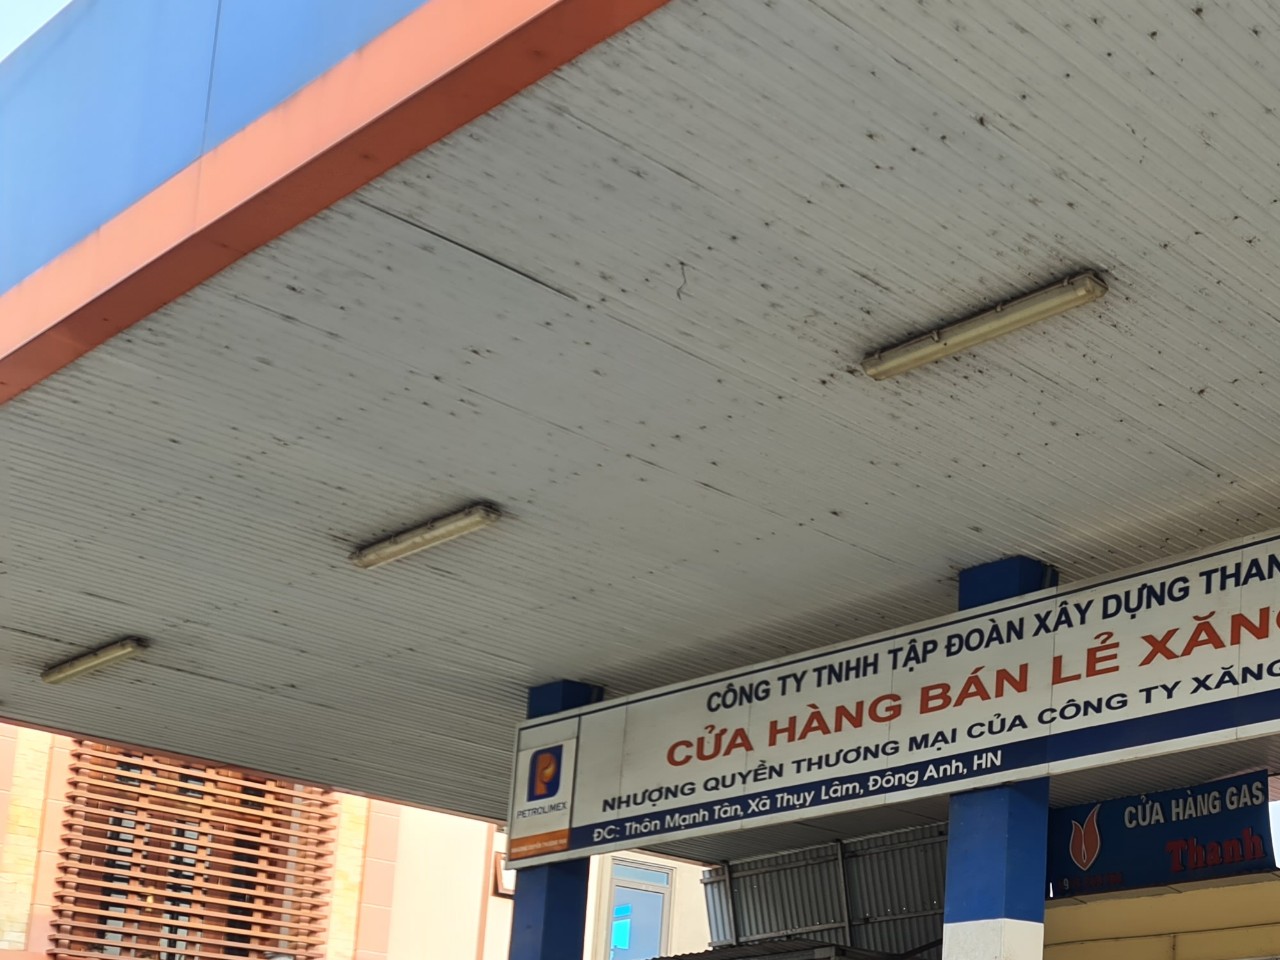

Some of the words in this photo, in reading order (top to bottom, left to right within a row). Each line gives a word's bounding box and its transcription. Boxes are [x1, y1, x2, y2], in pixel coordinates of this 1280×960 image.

[707, 680, 771, 712] CÔNG
[778, 671, 807, 696] TY
[813, 653, 879, 688] TNHH
[888, 638, 938, 672] TẬP
[945, 617, 1025, 657] ĐOÀN
[1033, 599, 1094, 638] XÂY
[1102, 576, 1190, 620] DỰNG
[667, 725, 754, 766] CỬA
[768, 693, 902, 747] HÀNG
[920, 662, 1029, 714] BÁN
[1052, 631, 1120, 685] LẺ
[602, 782, 696, 812] NHƯỢNG
[703, 760, 784, 792] QUYỀN
[792, 740, 900, 773] THƯƠNG
[908, 728, 957, 751] MẠI
[967, 713, 1028, 739] CỦA
[1037, 693, 1128, 725] CÔNG
[1138, 680, 1182, 704] TY
[517, 801, 568, 818] PETROLIMEX
[593, 825, 620, 842] ĐC:
[624, 818, 660, 836] Thôn
[664, 809, 709, 829] Mạnh
[713, 803, 744, 819] Tân,
[747, 798, 770, 814] Xã
[775, 790, 815, 809] Thụy
[821, 781, 864, 800] Lâm,
[868, 768, 919, 791] Đông
[923, 759, 968, 781] Anh,
[973, 750, 1002, 771] HN
[1124, 794, 1165, 829] CỬA
[1171, 789, 1222, 822] HÀNG
[1226, 781, 1265, 814] GAS
[1165, 826, 1266, 873] Thanh
